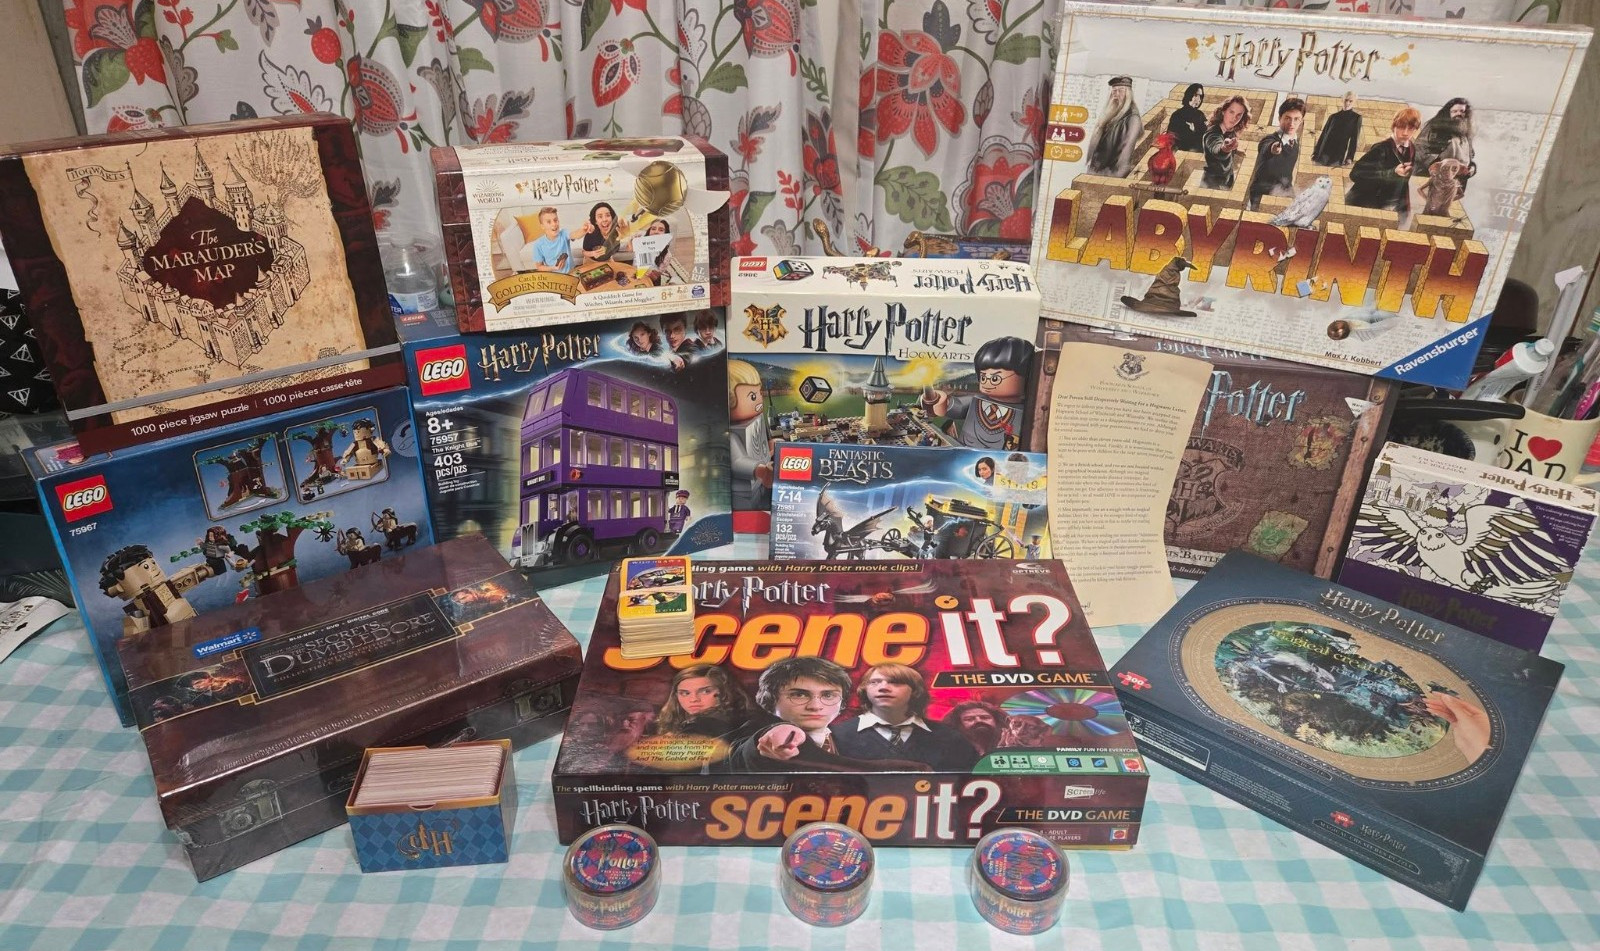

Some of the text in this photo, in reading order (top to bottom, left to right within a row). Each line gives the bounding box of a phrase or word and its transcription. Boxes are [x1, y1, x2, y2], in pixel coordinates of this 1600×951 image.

[1215, 31, 1380, 90] Harry Potter
[71, 167, 125, 180] HOGWARTS
[472, 191, 505, 199] WIZARDING
[531, 174, 600, 201] Harry Potter
[190, 228, 218, 246] The
[150, 238, 266, 272] MARAUDER'S
[1046, 188, 1489, 323] LABYRINTH
[193, 263, 236, 283] MAP
[518, 275, 537, 283] Catch
[914, 266, 1034, 294] Harry Potter
[495, 281, 573, 298] GOLDEN SNITCH
[661, 291, 674, 301] 8+
[798, 302, 972, 365] Harry Potter
[477, 333, 600, 382] Harry Potter
[898, 348, 970, 360] HOGWARTS
[1324, 350, 1341, 360] Max
[1351, 355, 1383, 367] Kobbert
[1394, 327, 1479, 376] Ravensburger
[423, 359, 465, 382] LEGO
[263, 377, 363, 407] 1000 pièces casse-tête
[1201, 370, 1307, 437] Potter
[131, 403, 250, 437] 1000 piece jigsaw puzzle
[427, 417, 454, 434] 8+
[429, 433, 459, 445] 75957
[444, 443, 465, 452] Knight
[1510, 429, 1528, 454] I
[434, 453, 463, 467] 403
[782, 457, 811, 470] LEGO
[828, 449, 885, 460] FANTASTIC
[435, 465, 468, 479] pcs/pzs
[818, 459, 894, 482] BEASTS
[777, 490, 802, 502] 7-14
[1479, 471, 1575, 501] Harry Potter
[64, 485, 106, 511] LEGO
[69, 522, 98, 537] 75967
[775, 525, 793, 533] 132
[719, 564, 754, 574] game
[757, 563, 782, 572] with
[784, 563, 816, 574] Harry
[819, 563, 853, 572] Potter
[855, 563, 887, 572] movie
[889, 563, 919, 573] clips!
[692, 576, 831, 617] arry Potter
[1320, 588, 1445, 645] Harry Potter
[305, 621, 382, 651] SECRETS
[934, 594, 1072, 668] it?
[196, 636, 242, 653] Walmart
[260, 612, 436, 678] DUMBLEDORE
[1266, 628, 1330, 656] magical
[950, 673, 1094, 684] THE DVD GAME
[1125, 674, 1145, 686] 300
[573, 784, 633, 793] spellbinding
[636, 785, 663, 793] game
[665, 783, 685, 791] with
[686, 783, 711, 792] Harry
[713, 783, 738, 791] Potter
[740, 783, 764, 791] movie
[767, 783, 789, 792] clips!
[580, 796, 700, 828] Harry Potter
[705, 780, 1001, 840] scene it?
[1015, 810, 1130, 820] THE DVD GAME
[1360, 824, 1408, 852] Harry Potter
